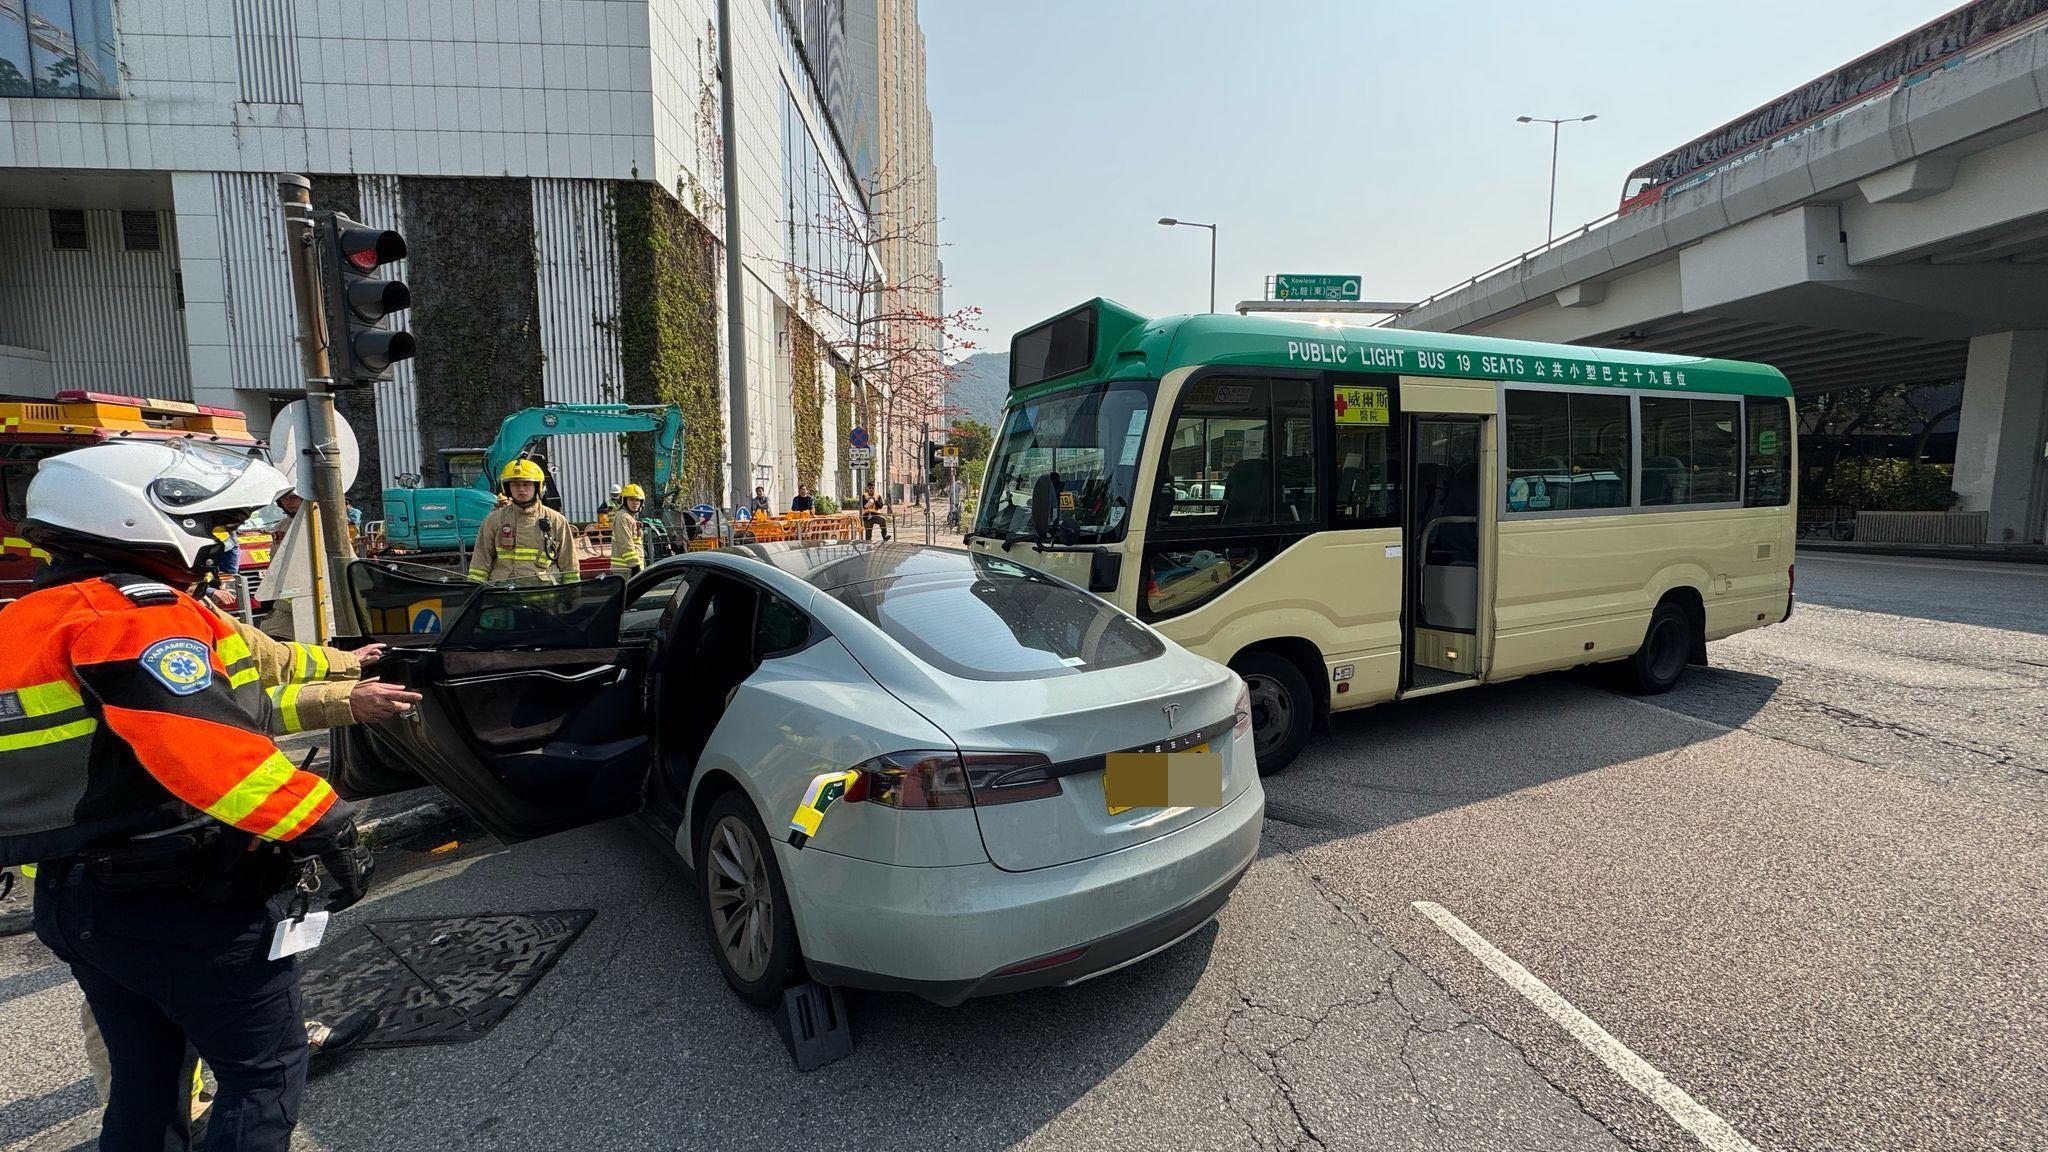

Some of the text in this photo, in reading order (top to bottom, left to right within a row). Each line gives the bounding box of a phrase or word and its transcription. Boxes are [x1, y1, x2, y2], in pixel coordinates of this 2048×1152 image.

[1288, 341, 1525, 375] PUBLIC LIGHT BUS 19 SEATS
[1534, 360, 1687, 386] 公共小型巴士十九座位
[1348, 390, 1388, 408] 威爾斯
[1360, 410, 1378, 422] 醫院
[147, 642, 204, 663] PARAMEDIC
